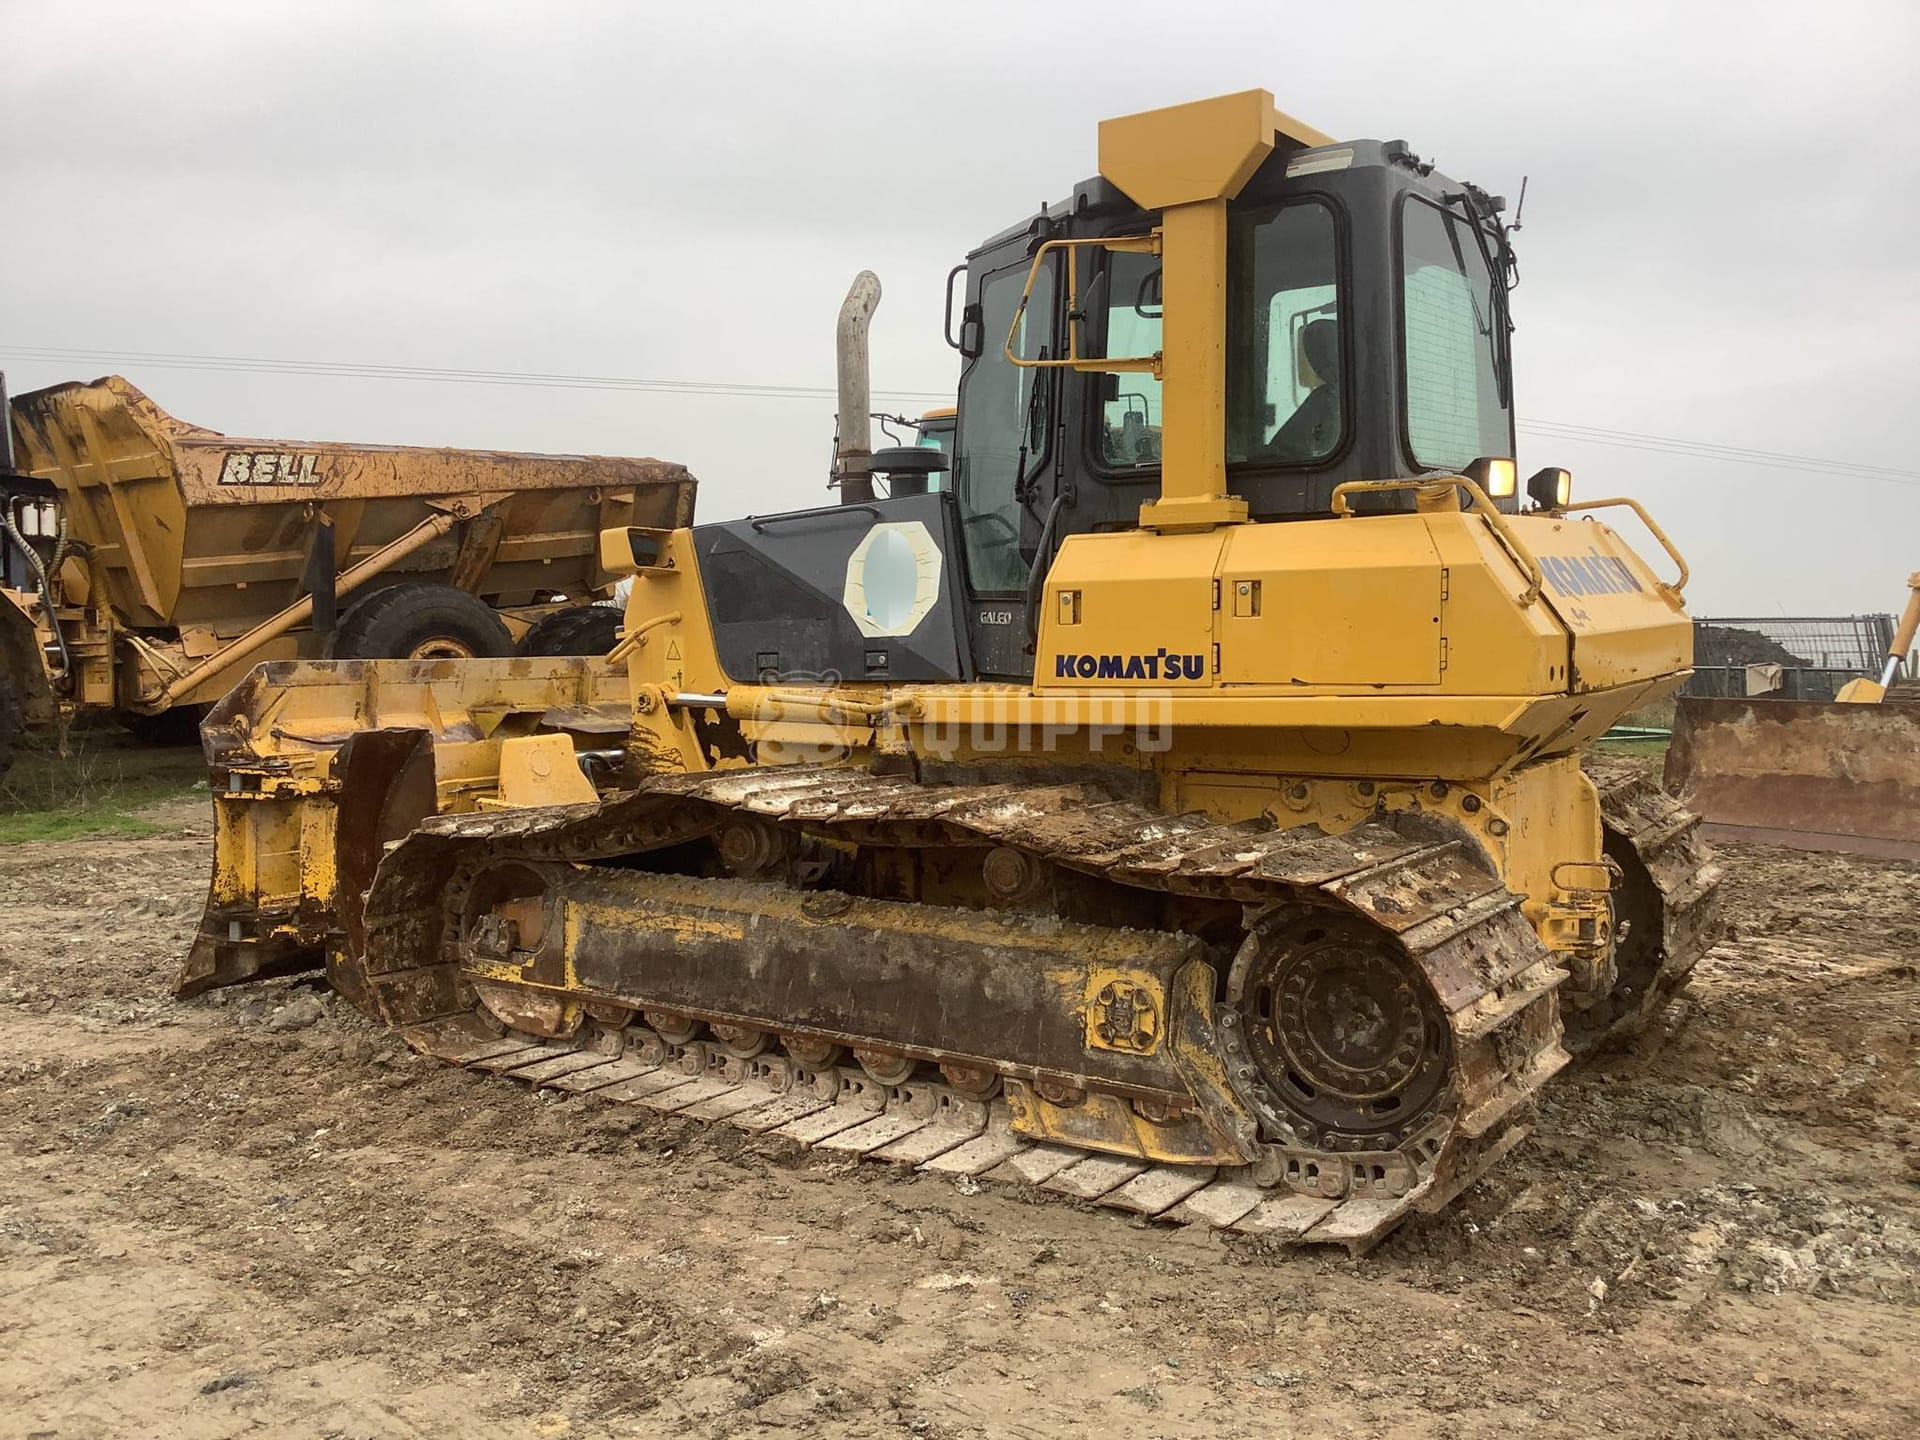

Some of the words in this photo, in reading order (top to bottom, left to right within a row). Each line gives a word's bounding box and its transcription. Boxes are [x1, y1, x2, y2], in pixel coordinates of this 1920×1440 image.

[218, 451, 324, 486] BELL
[1535, 546, 1643, 598] KOMATSU
[980, 611, 1012, 625] GALEO
[1056, 648, 1204, 680] KOMATSU
